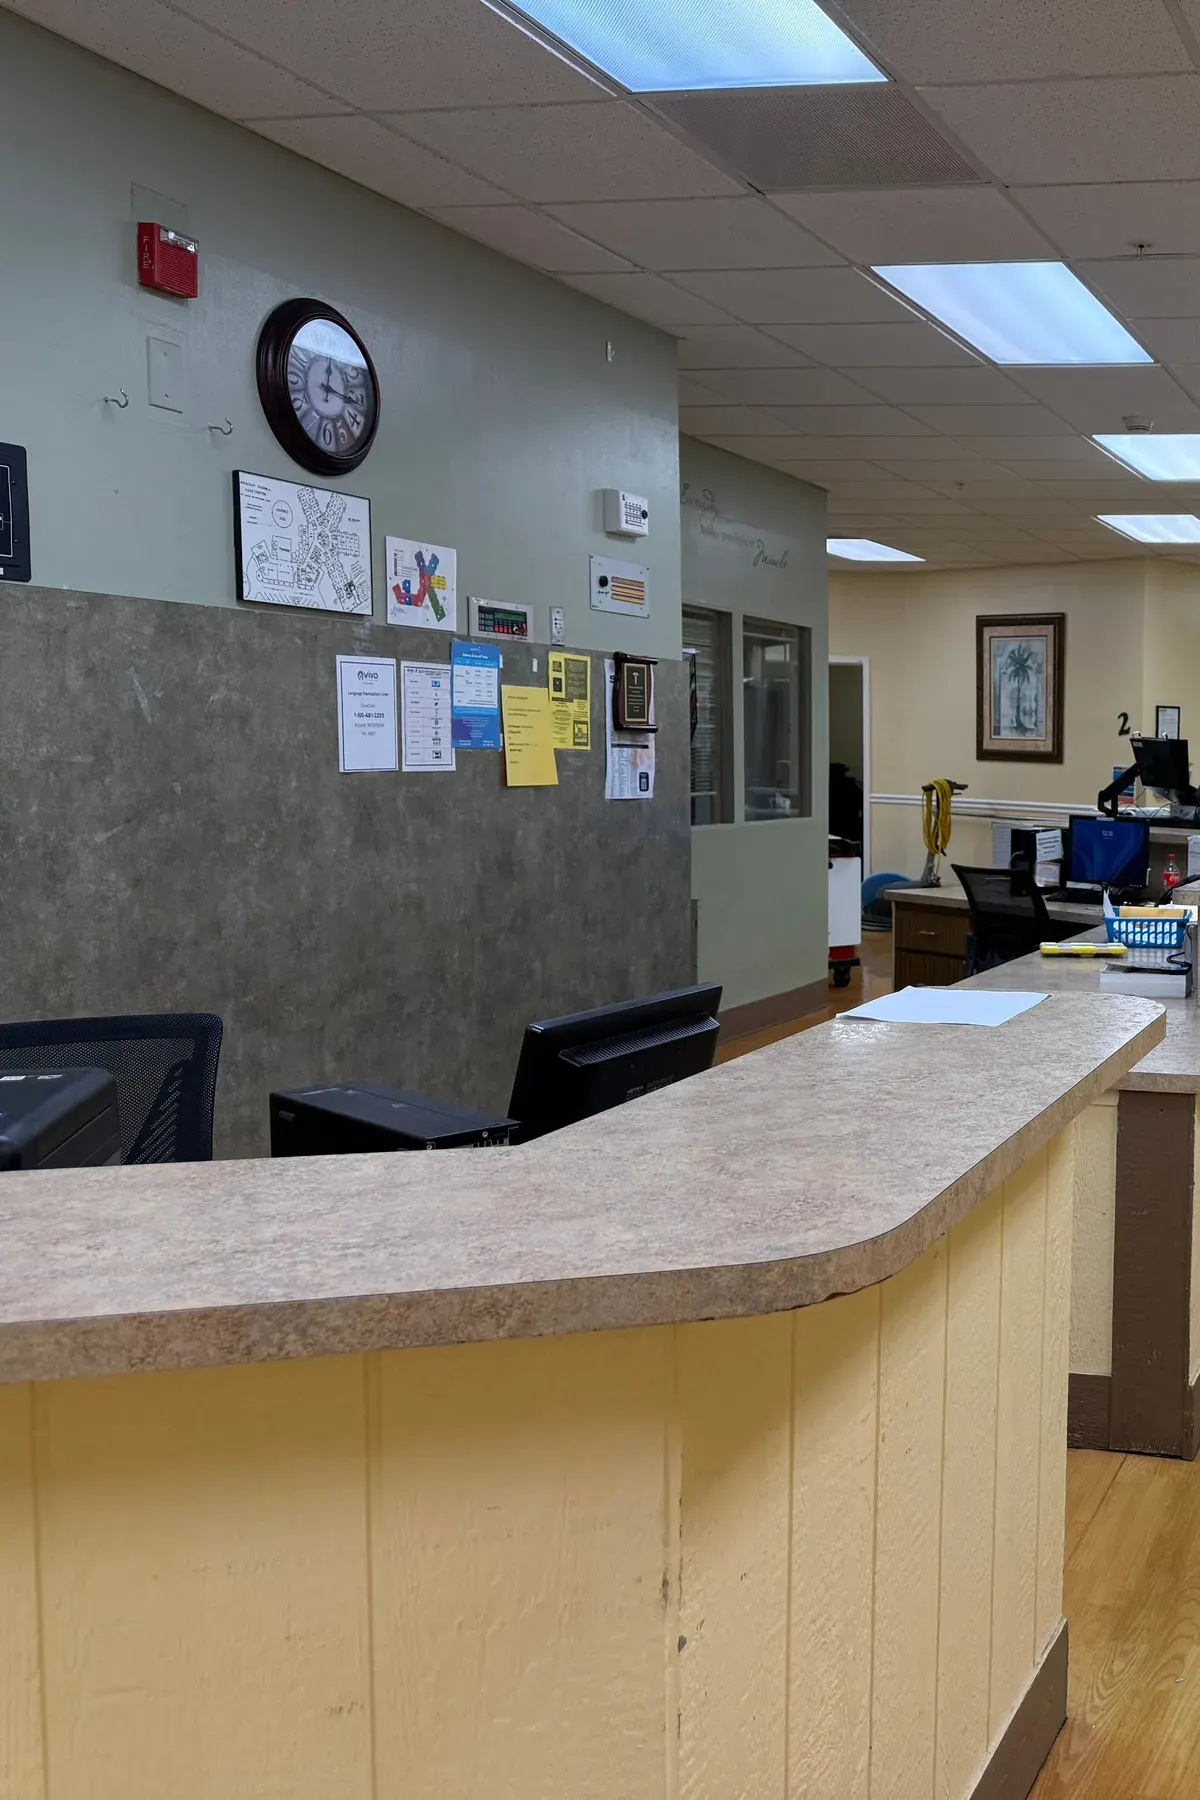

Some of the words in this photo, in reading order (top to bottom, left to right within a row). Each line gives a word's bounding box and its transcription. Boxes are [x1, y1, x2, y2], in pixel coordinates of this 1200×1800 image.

[346, 408, 362, 429] 4
[322, 422, 332, 446] 6
[1117, 712, 1131, 736] 2
